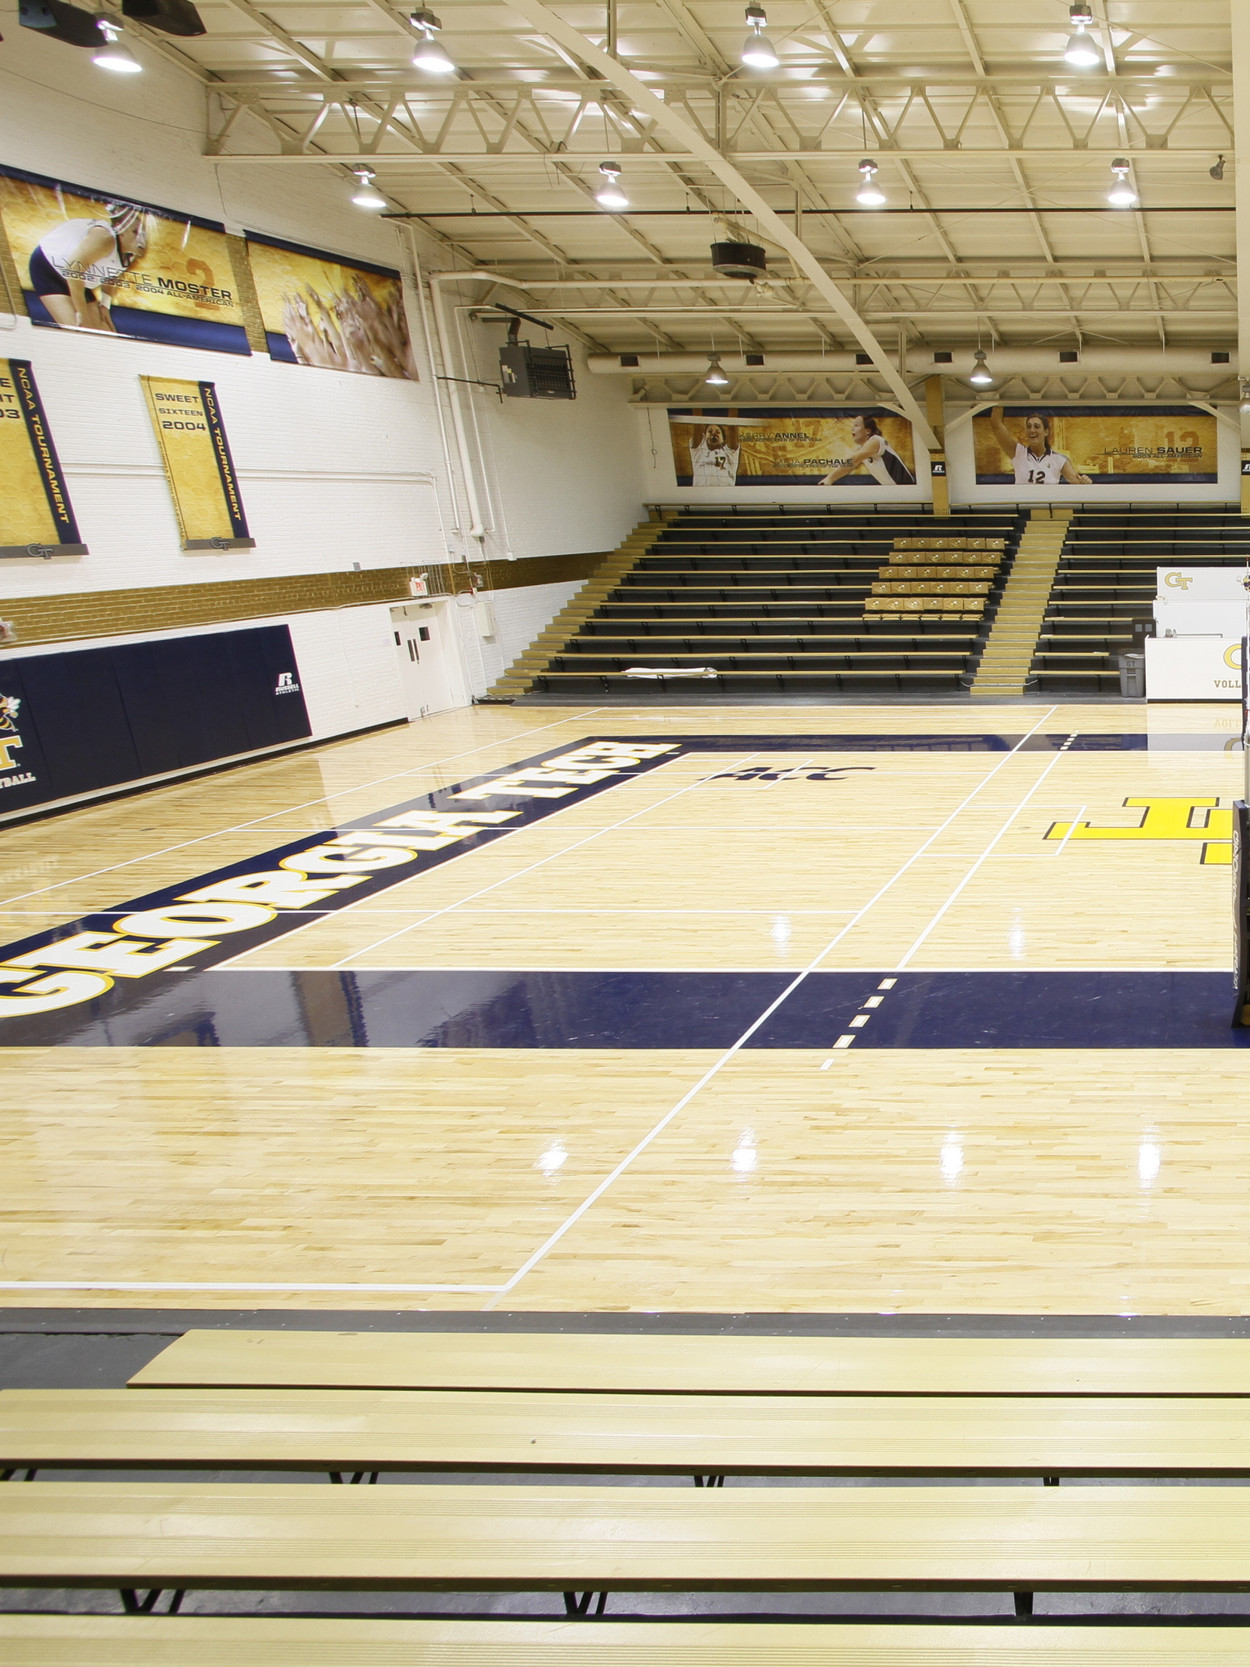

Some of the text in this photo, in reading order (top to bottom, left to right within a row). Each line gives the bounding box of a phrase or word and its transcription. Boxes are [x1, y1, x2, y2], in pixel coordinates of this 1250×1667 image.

[51, 256, 232, 300] LYNNETTE MOSTER
[135, 284, 165, 295] 2004
[166, 290, 234, 308] ALL-AMERICAN
[155, 393, 200, 404] SWEET
[158, 407, 204, 417] SIXTEEN
[162, 420, 206, 431] 2004
[18, 367, 70, 524] NCAA TOURNAMENT
[204, 387, 242, 521] NCAA TOURNAMENT
[1028, 469, 1046, 484] 12
[27, 542, 54, 560] GT
[210, 537, 231, 551] GT
[1164, 571, 1193, 590] GT
[278, 672, 293, 687] R
[696, 766, 877, 781] ACC
[0, 741, 683, 1019] GEORGIA TECH
